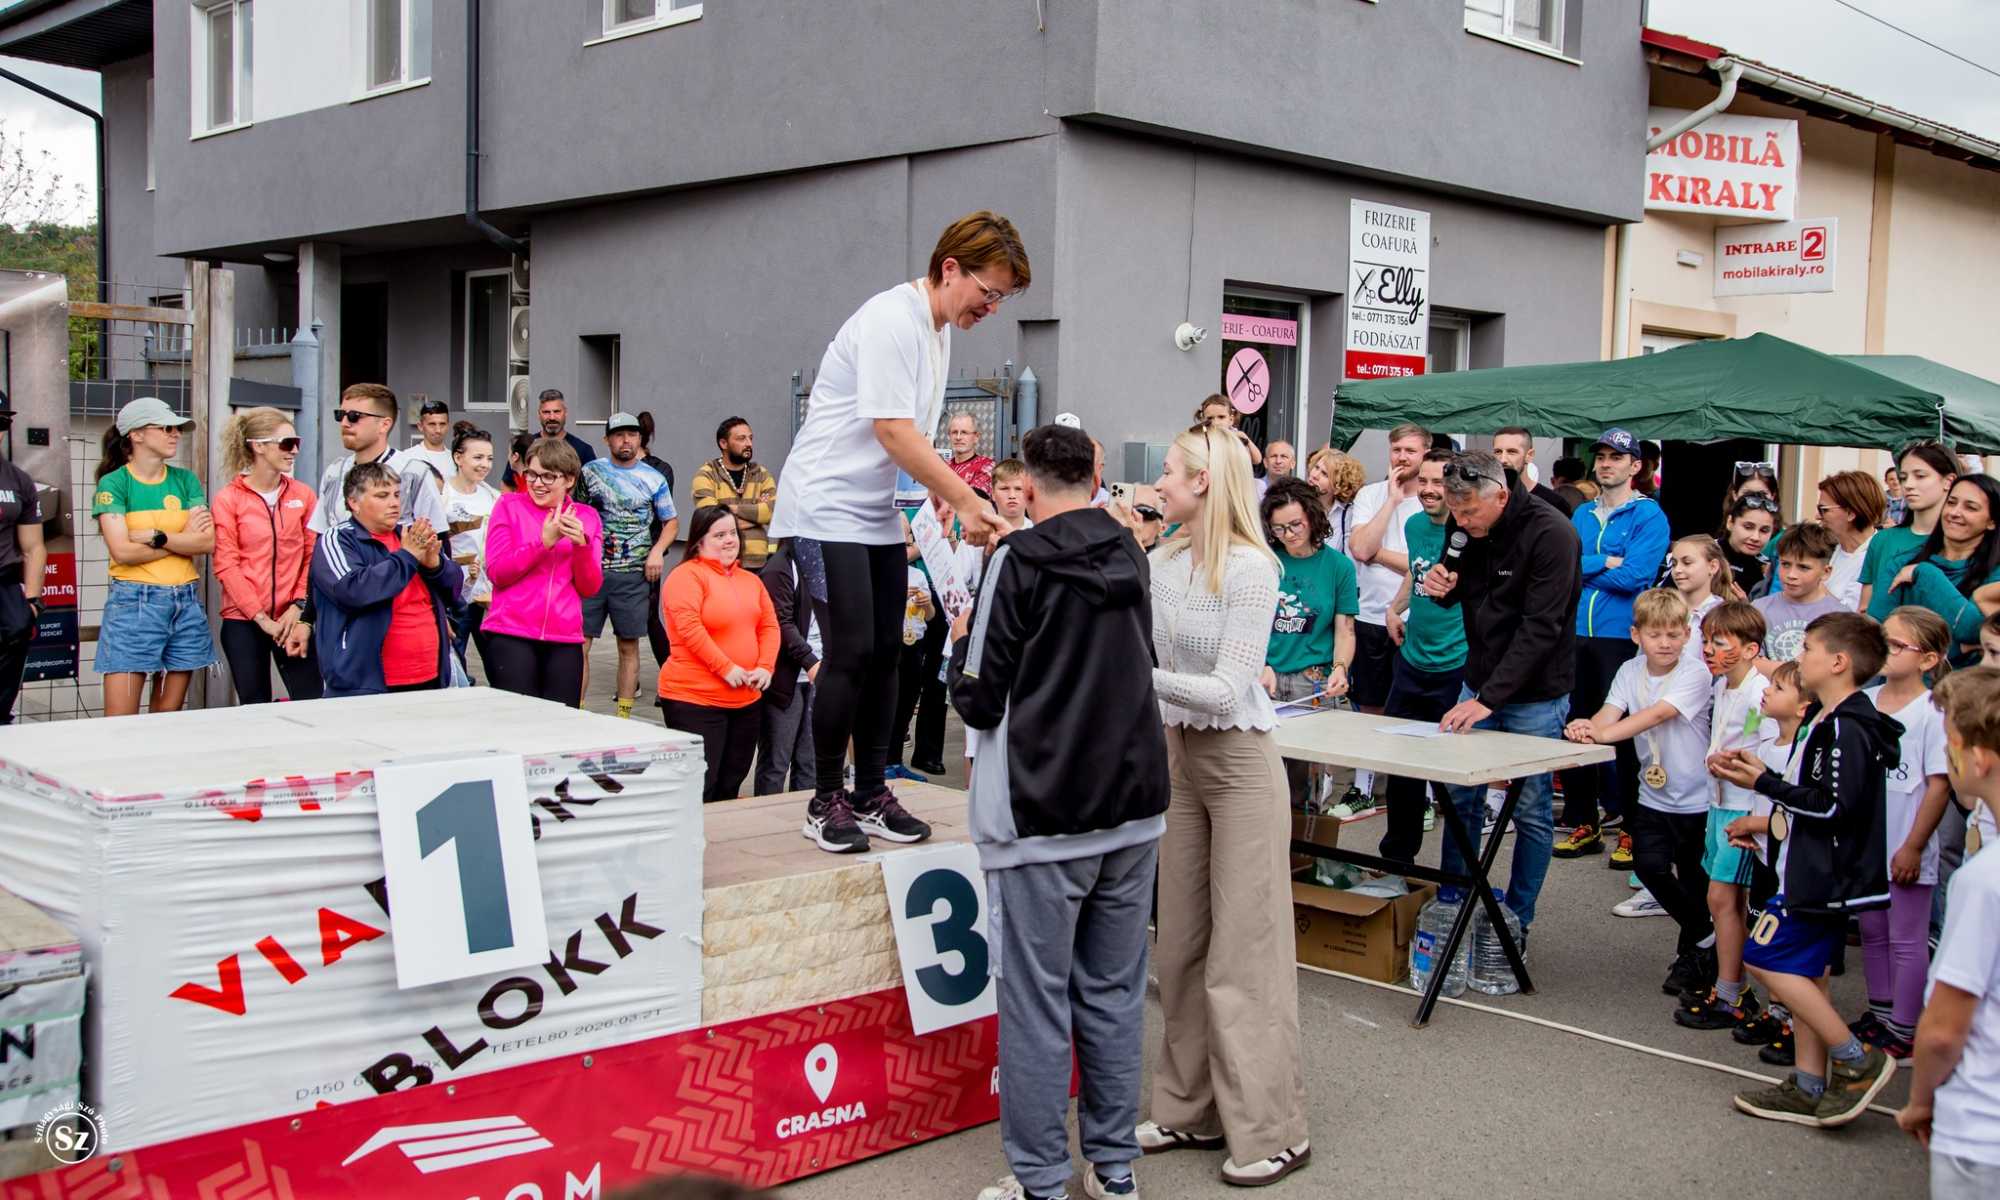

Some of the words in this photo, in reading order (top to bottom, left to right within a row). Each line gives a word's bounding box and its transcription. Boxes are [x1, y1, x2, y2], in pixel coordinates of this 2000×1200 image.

[1649, 172, 1782, 211] KIRALY
[1365, 210, 1416, 232] FRIZERIE
[1725, 240, 1798, 256] INTRARE
[1804, 231, 1824, 258] 2
[1723, 264, 1824, 280] mobilakiraly.ro
[1378, 266, 1424, 325] Elly
[1367, 312, 1383, 324] 0771
[1353, 329, 1422, 350] FODRÁSZAT
[1372, 364, 1389, 376] 0771
[416, 779, 514, 955] 1
[905, 868, 991, 1007] 3
[360, 892, 666, 1096] BLOKK
[776, 1101, 867, 1139] CRASNA
